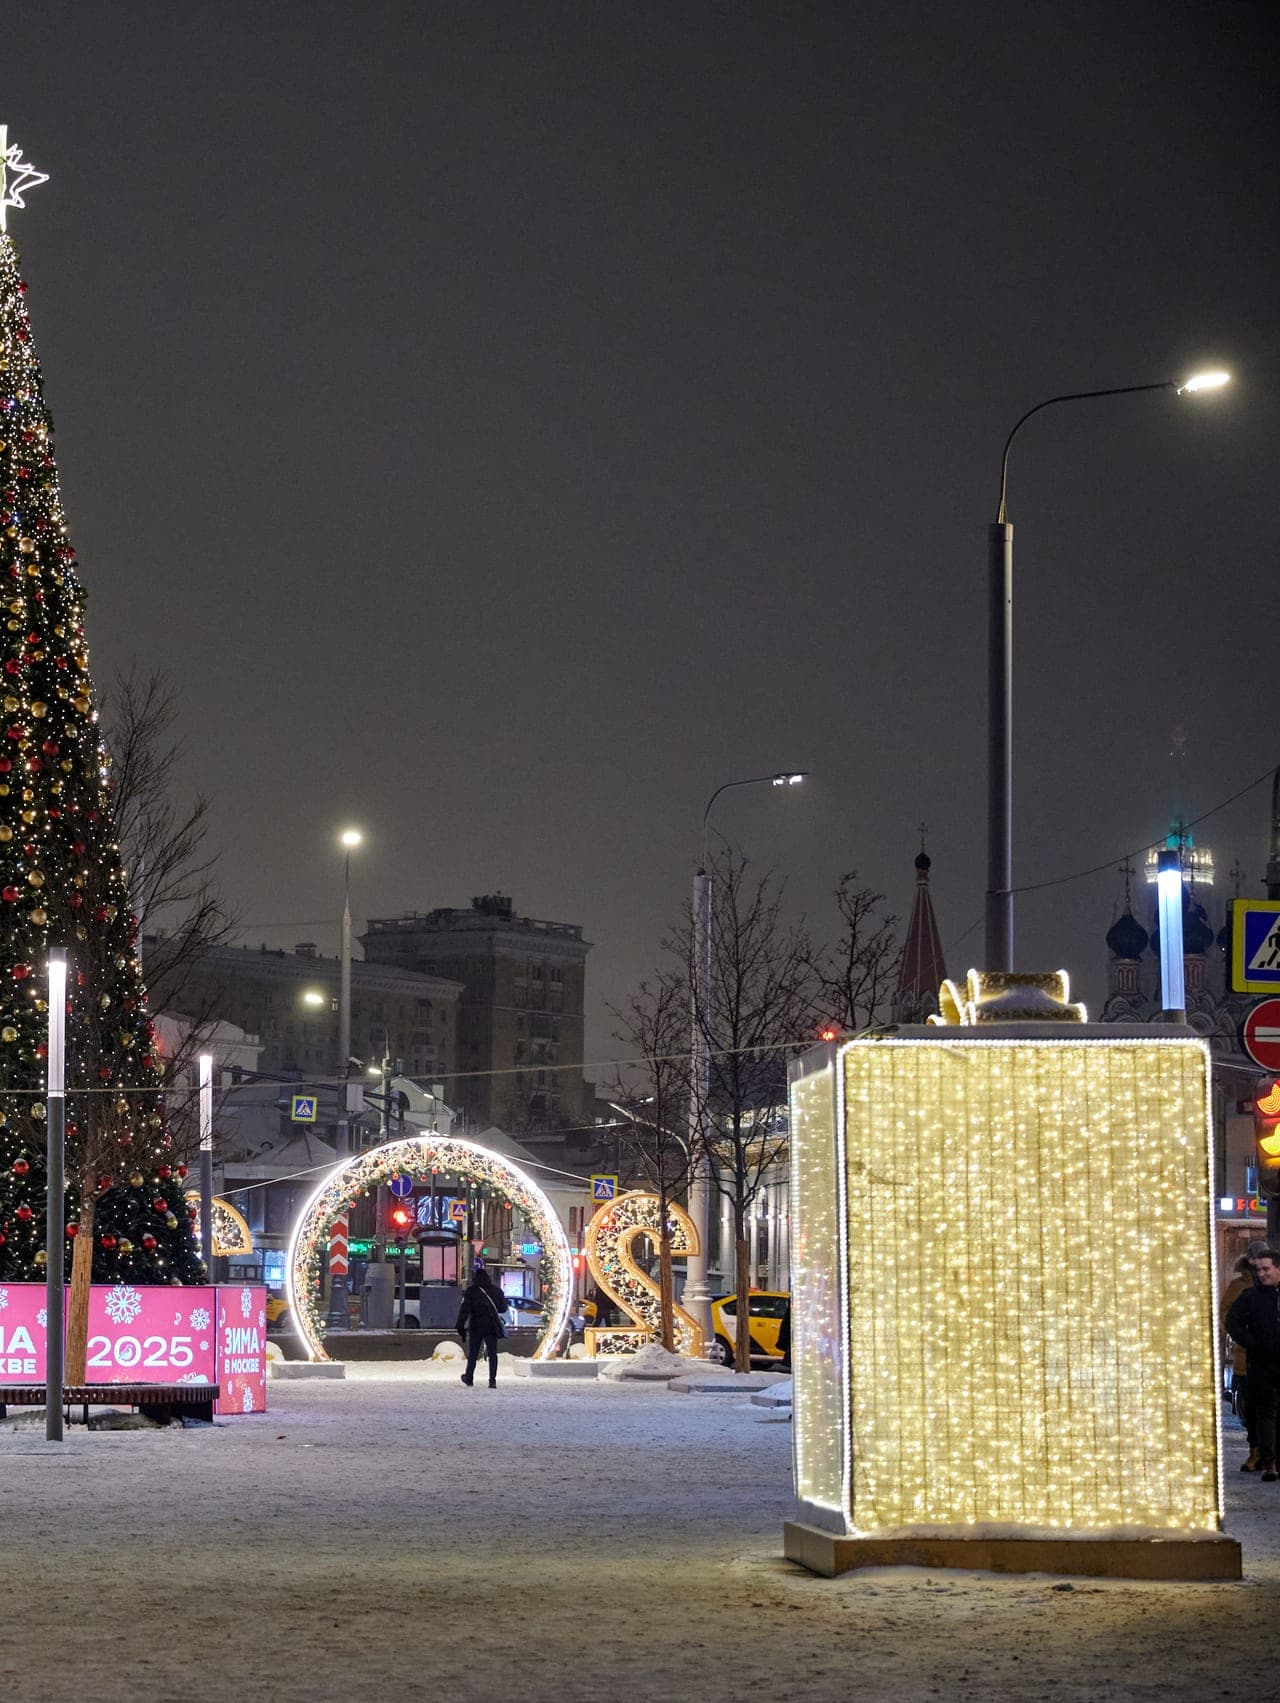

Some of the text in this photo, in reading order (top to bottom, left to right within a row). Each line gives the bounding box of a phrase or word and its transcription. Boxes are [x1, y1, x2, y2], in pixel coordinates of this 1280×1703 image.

[87, 1335, 193, 1367] 2025
[224, 1327, 260, 1355] ЗИМА
[224, 1357, 260, 1374] В МОСКВЕ
